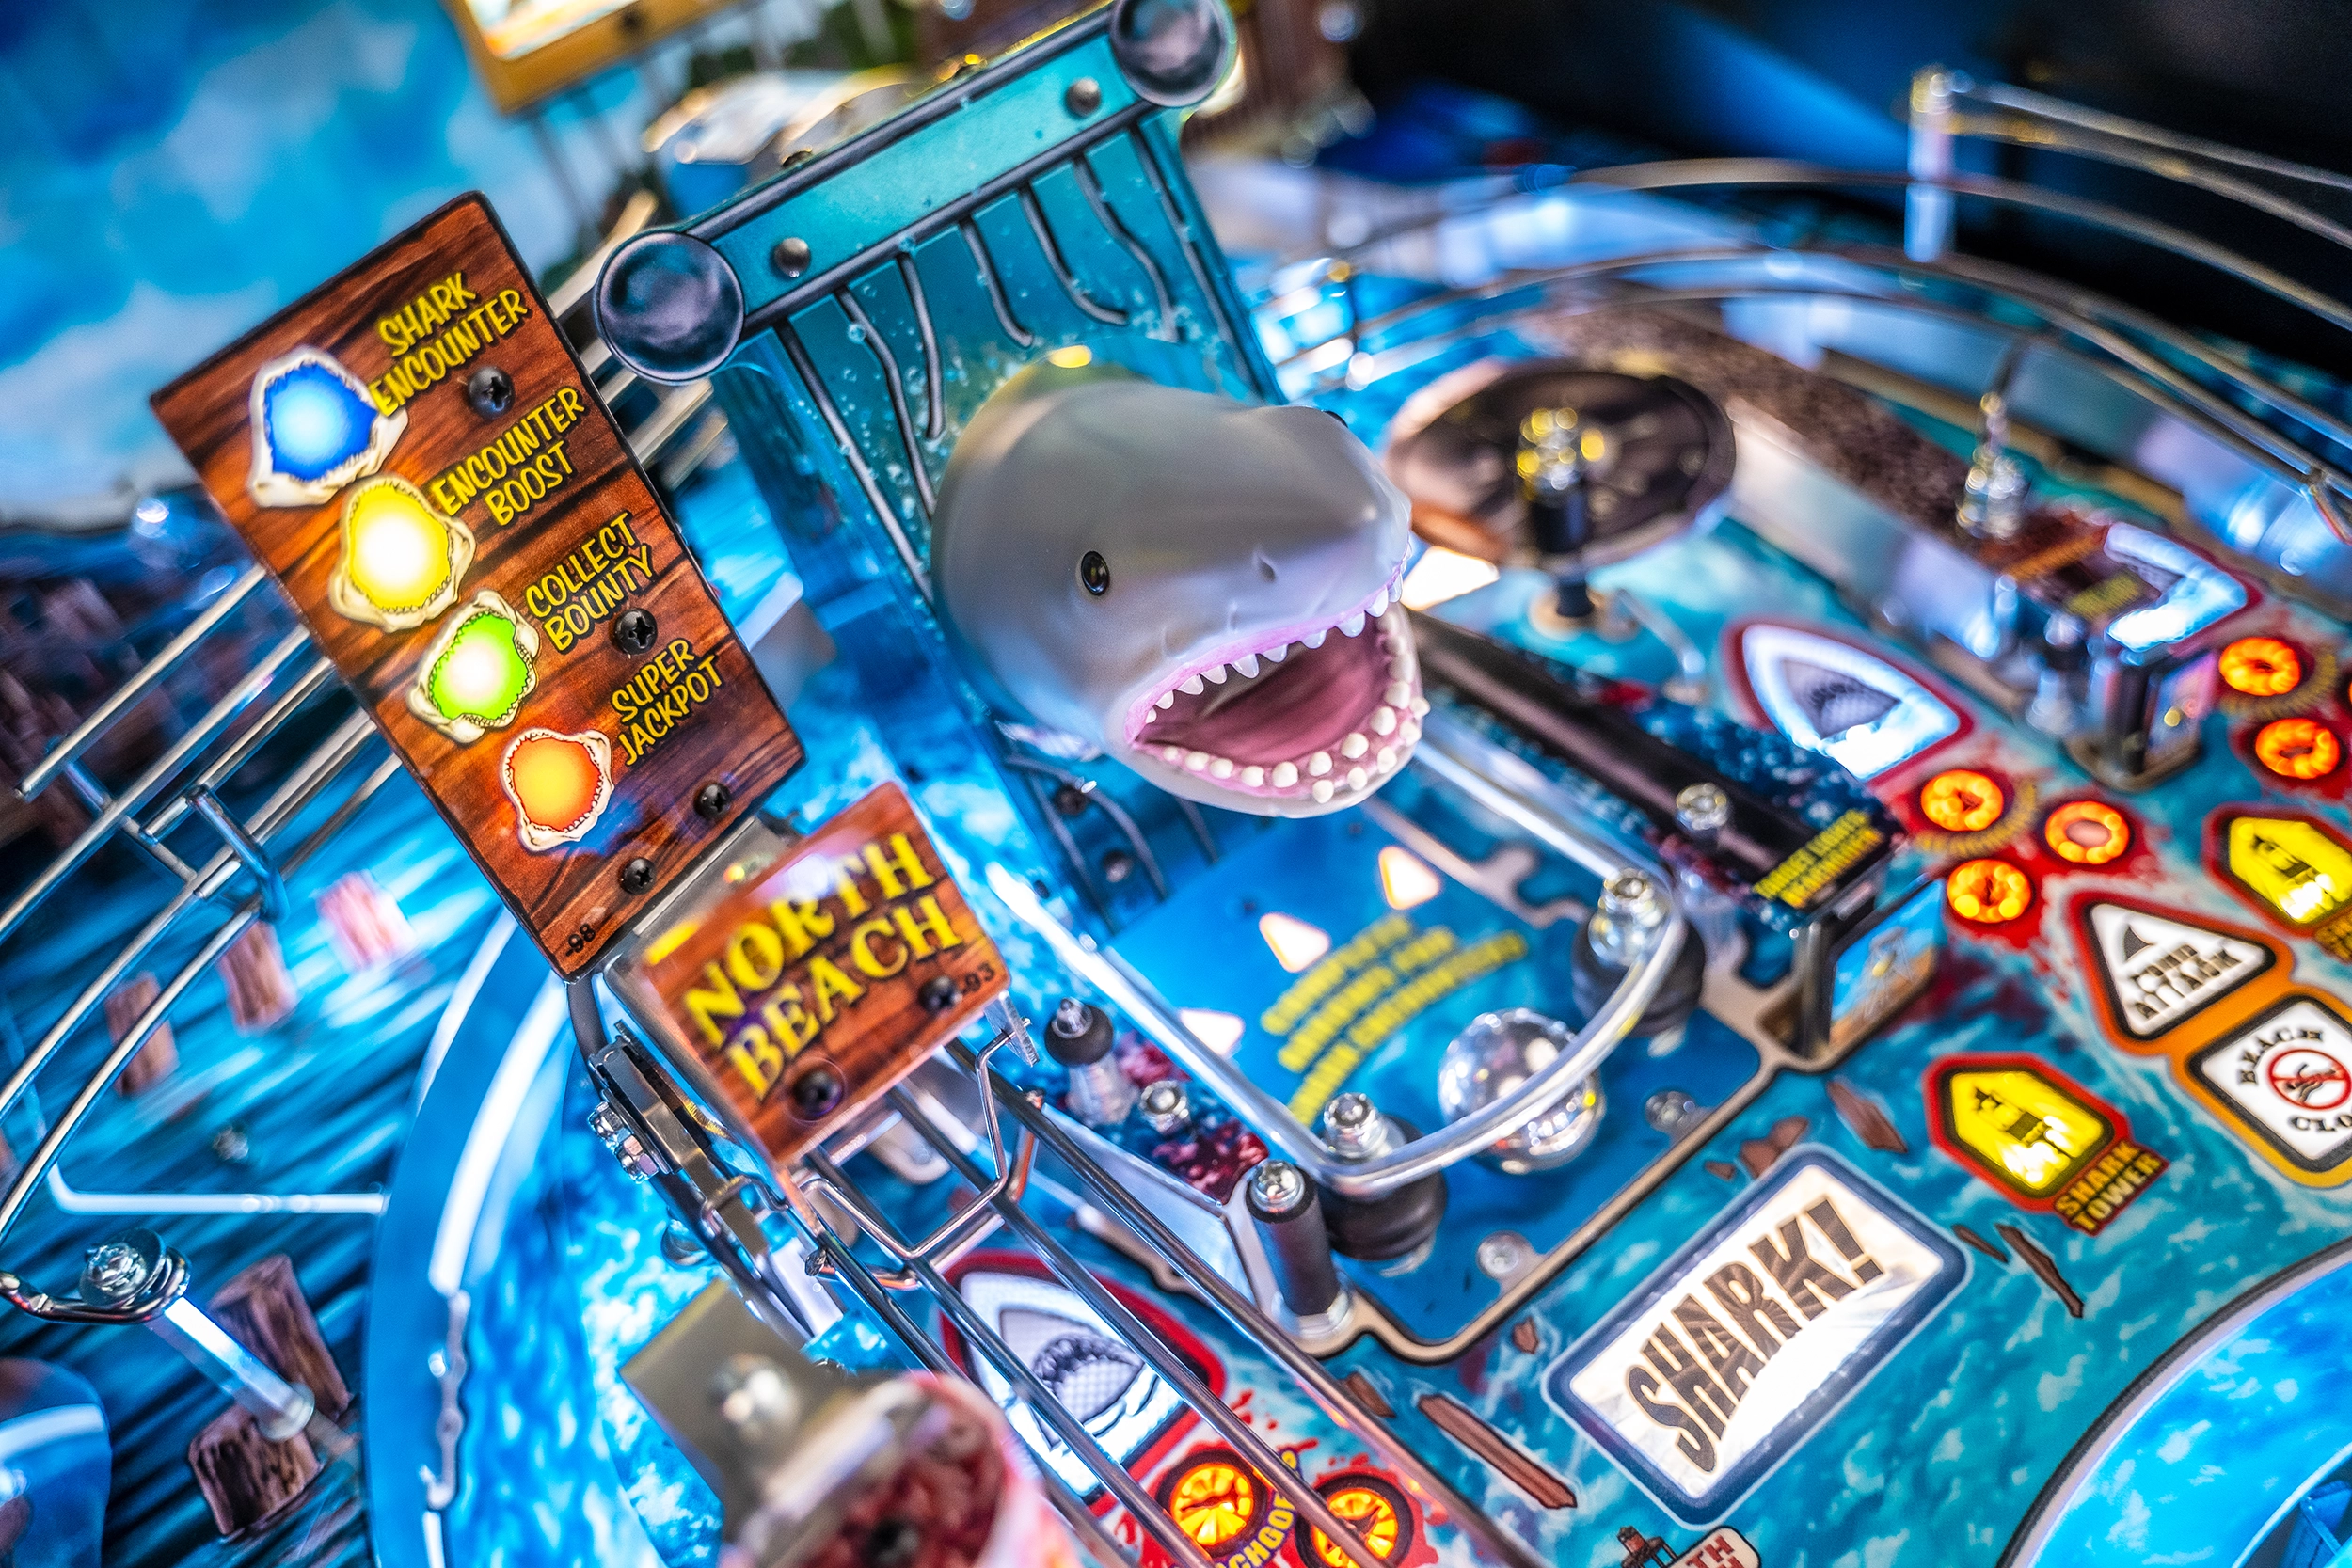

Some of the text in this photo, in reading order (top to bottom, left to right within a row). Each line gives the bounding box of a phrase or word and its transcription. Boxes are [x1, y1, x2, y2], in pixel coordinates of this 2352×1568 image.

[368, 288, 528, 417] ENCOUNTER
[378, 272, 476, 357] SHARK
[430, 388, 585, 516] ENCOUNTER
[485, 440, 573, 526] BOOST
[526, 512, 636, 618] COLLECT
[543, 545, 653, 651] BOUNTY
[612, 639, 695, 723] SUPER
[618, 655, 723, 766] JACKPOT
[565, 923, 596, 958] -98
[684, 832, 936, 1051] NORTH
[726, 895, 964, 1101] BEACH
[2237, 1027, 2324, 1085] BEACH
[2055, 1140, 2141, 1216] SHARK
[2071, 1152, 2162, 1232] TOWER
[1626, 1193, 1885, 1474] SHARK!
